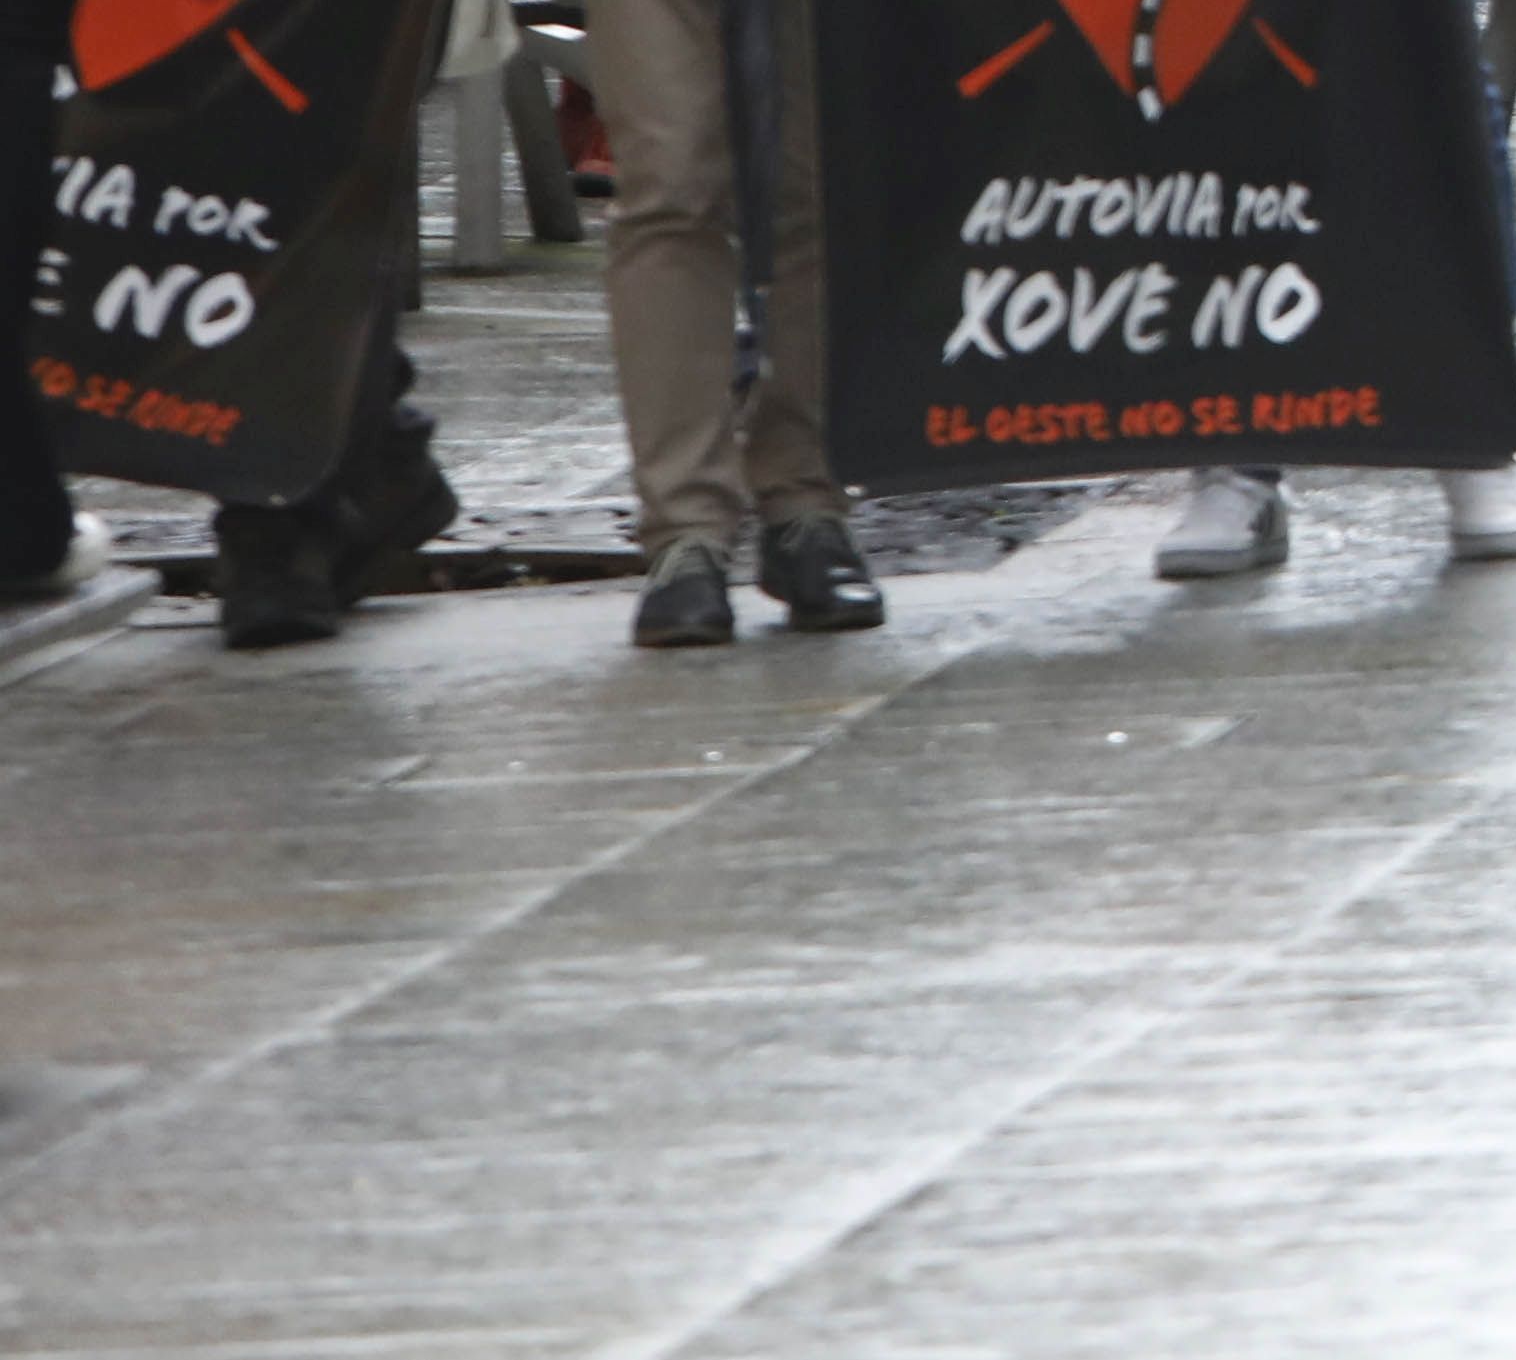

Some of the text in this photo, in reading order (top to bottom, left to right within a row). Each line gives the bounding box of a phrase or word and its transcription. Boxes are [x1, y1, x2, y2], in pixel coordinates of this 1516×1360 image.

[153, 186, 281, 252] POR
[960, 171, 1322, 245] AUTOVIA POR
[94, 265, 256, 349] NO
[942, 261, 1322, 364] XOVE NO
[926, 385, 1382, 447] EL OESTE NO SE RINDE
